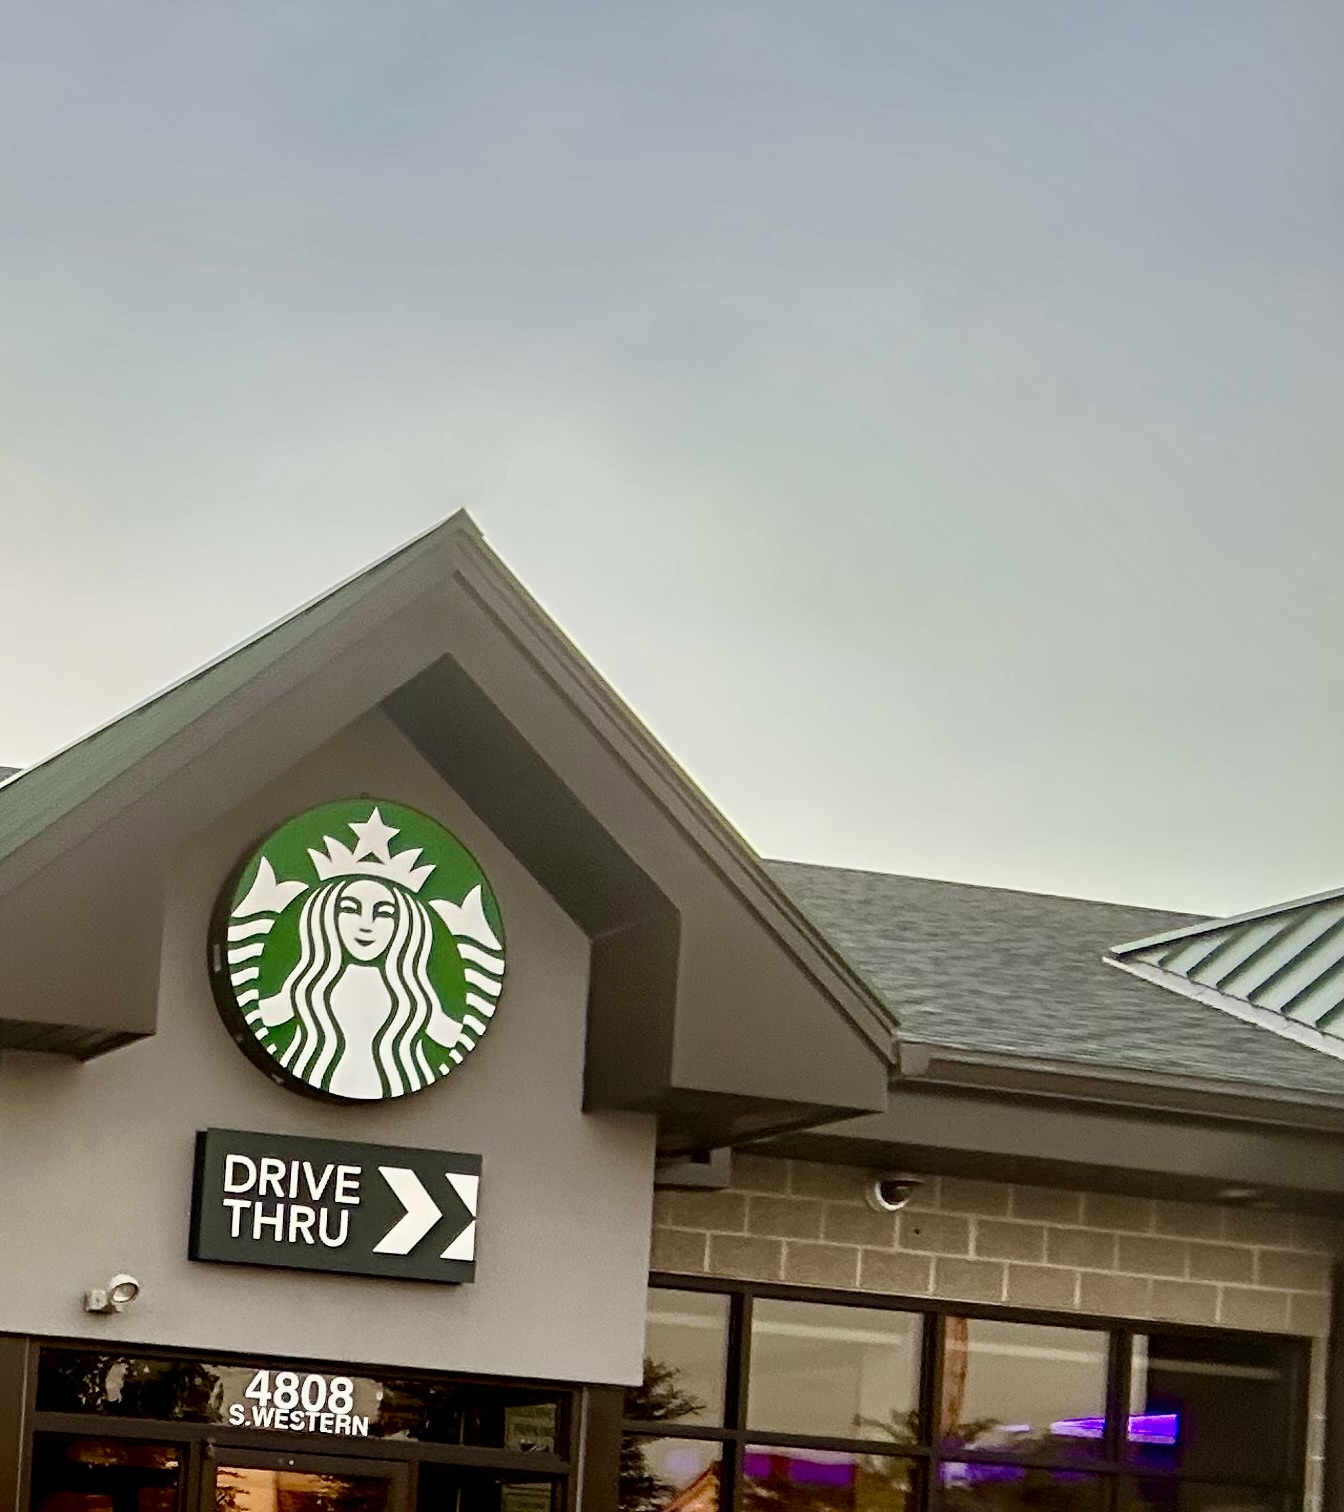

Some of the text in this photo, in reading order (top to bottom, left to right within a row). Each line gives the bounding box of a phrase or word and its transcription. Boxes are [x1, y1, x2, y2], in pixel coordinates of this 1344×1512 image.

[223, 1153, 362, 1205] DRIVE
[222, 1198, 350, 1248] THRU
[244, 1369, 354, 1415] 4808
